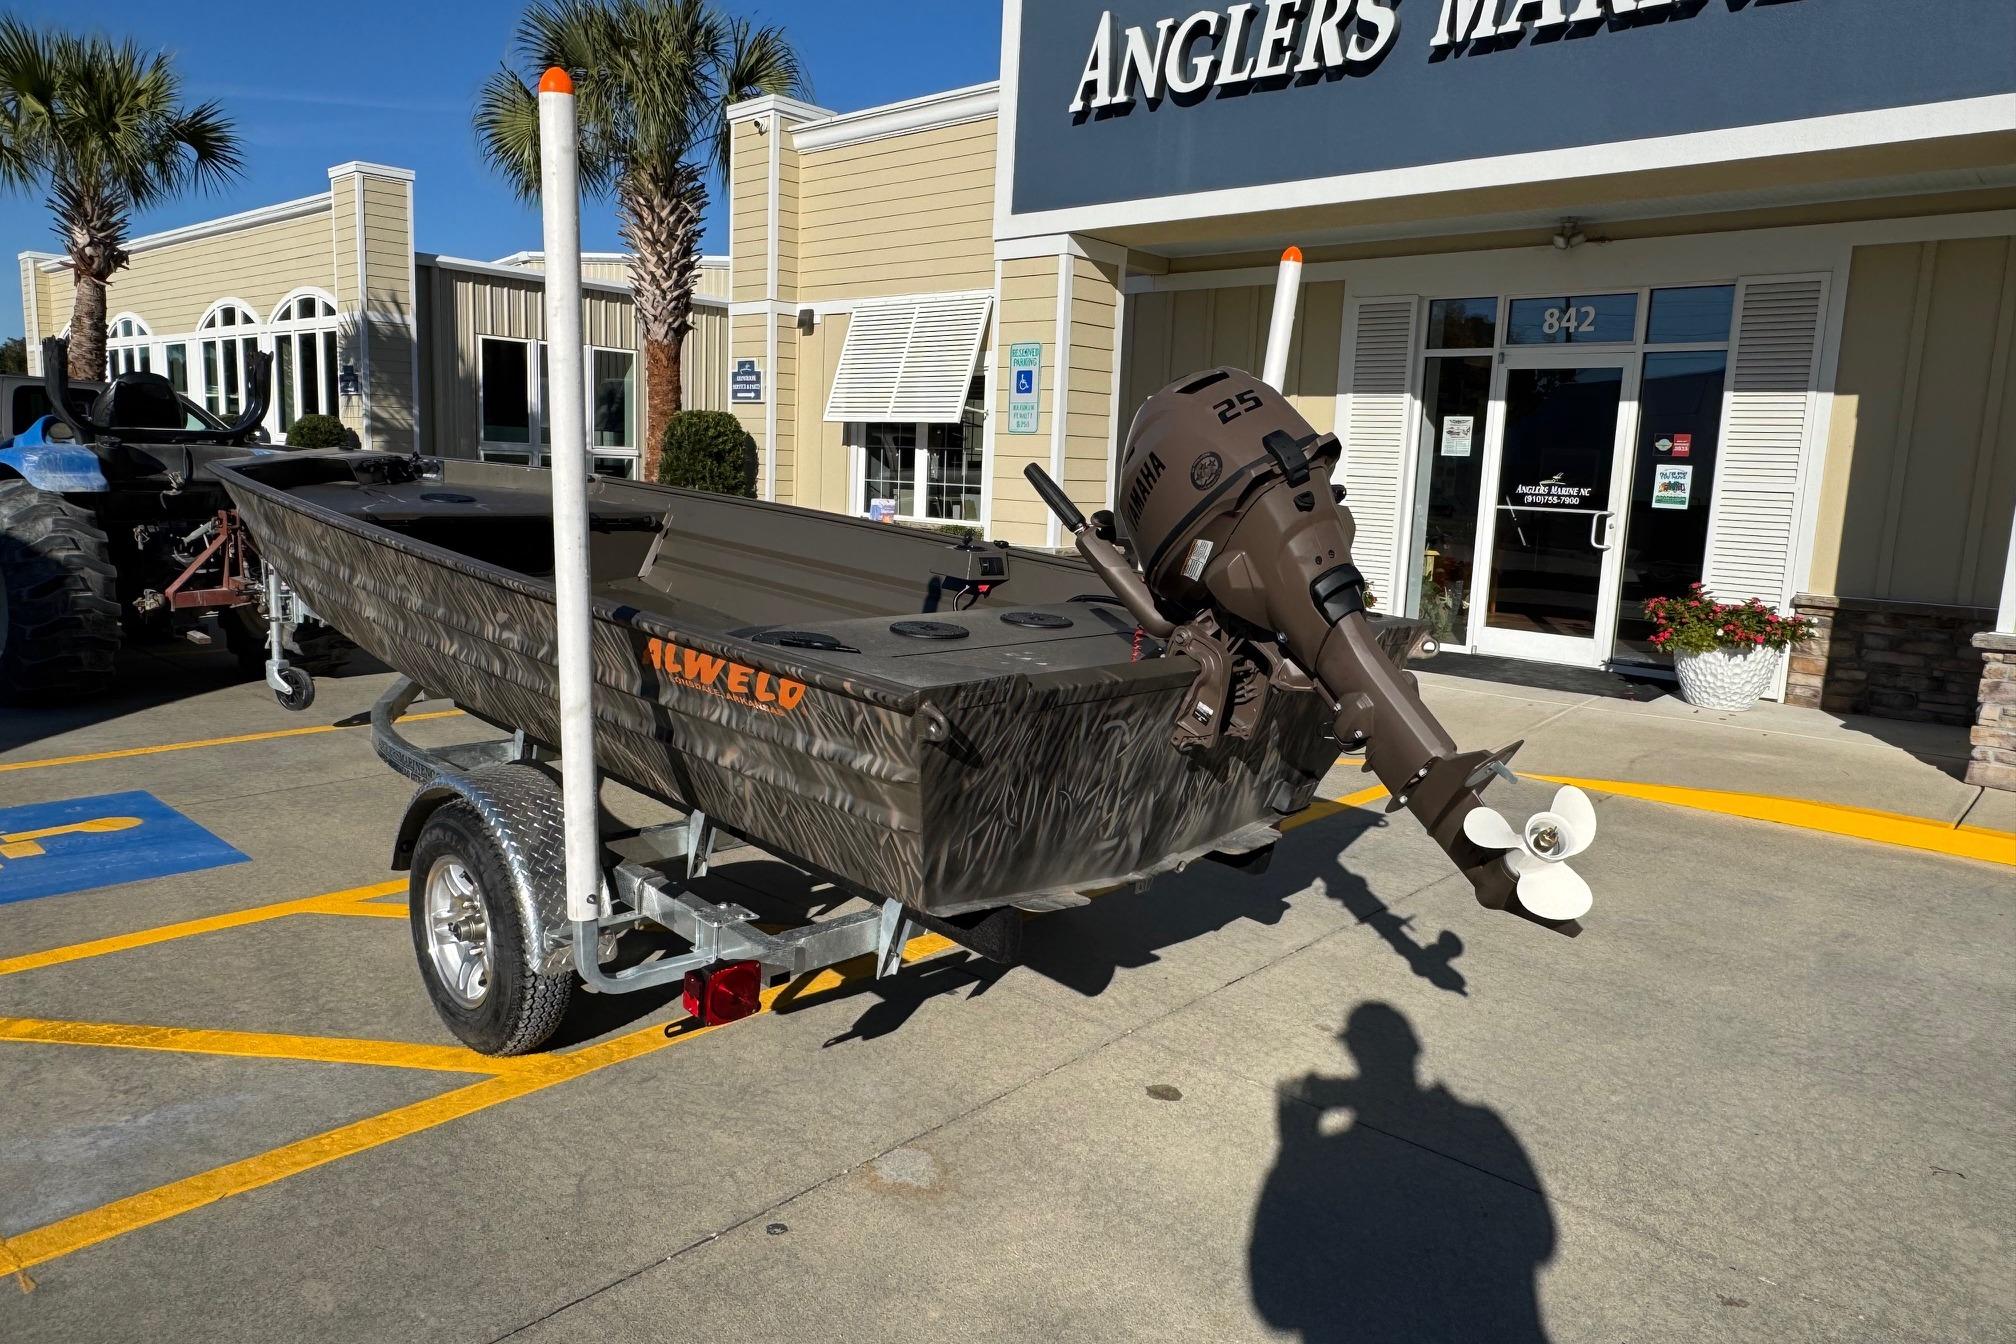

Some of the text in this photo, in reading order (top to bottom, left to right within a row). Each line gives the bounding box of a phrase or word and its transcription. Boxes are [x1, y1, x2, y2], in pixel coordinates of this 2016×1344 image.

[1068, 0, 1399, 113] ANGLERS
[1542, 306, 1596, 334] 842
[1013, 358, 1038, 367] PARKING
[1212, 389, 1264, 425] 25
[1515, 484, 1592, 497] ANGLERS MARINE NC
[1524, 495, 1580, 505] (910)755-7900
